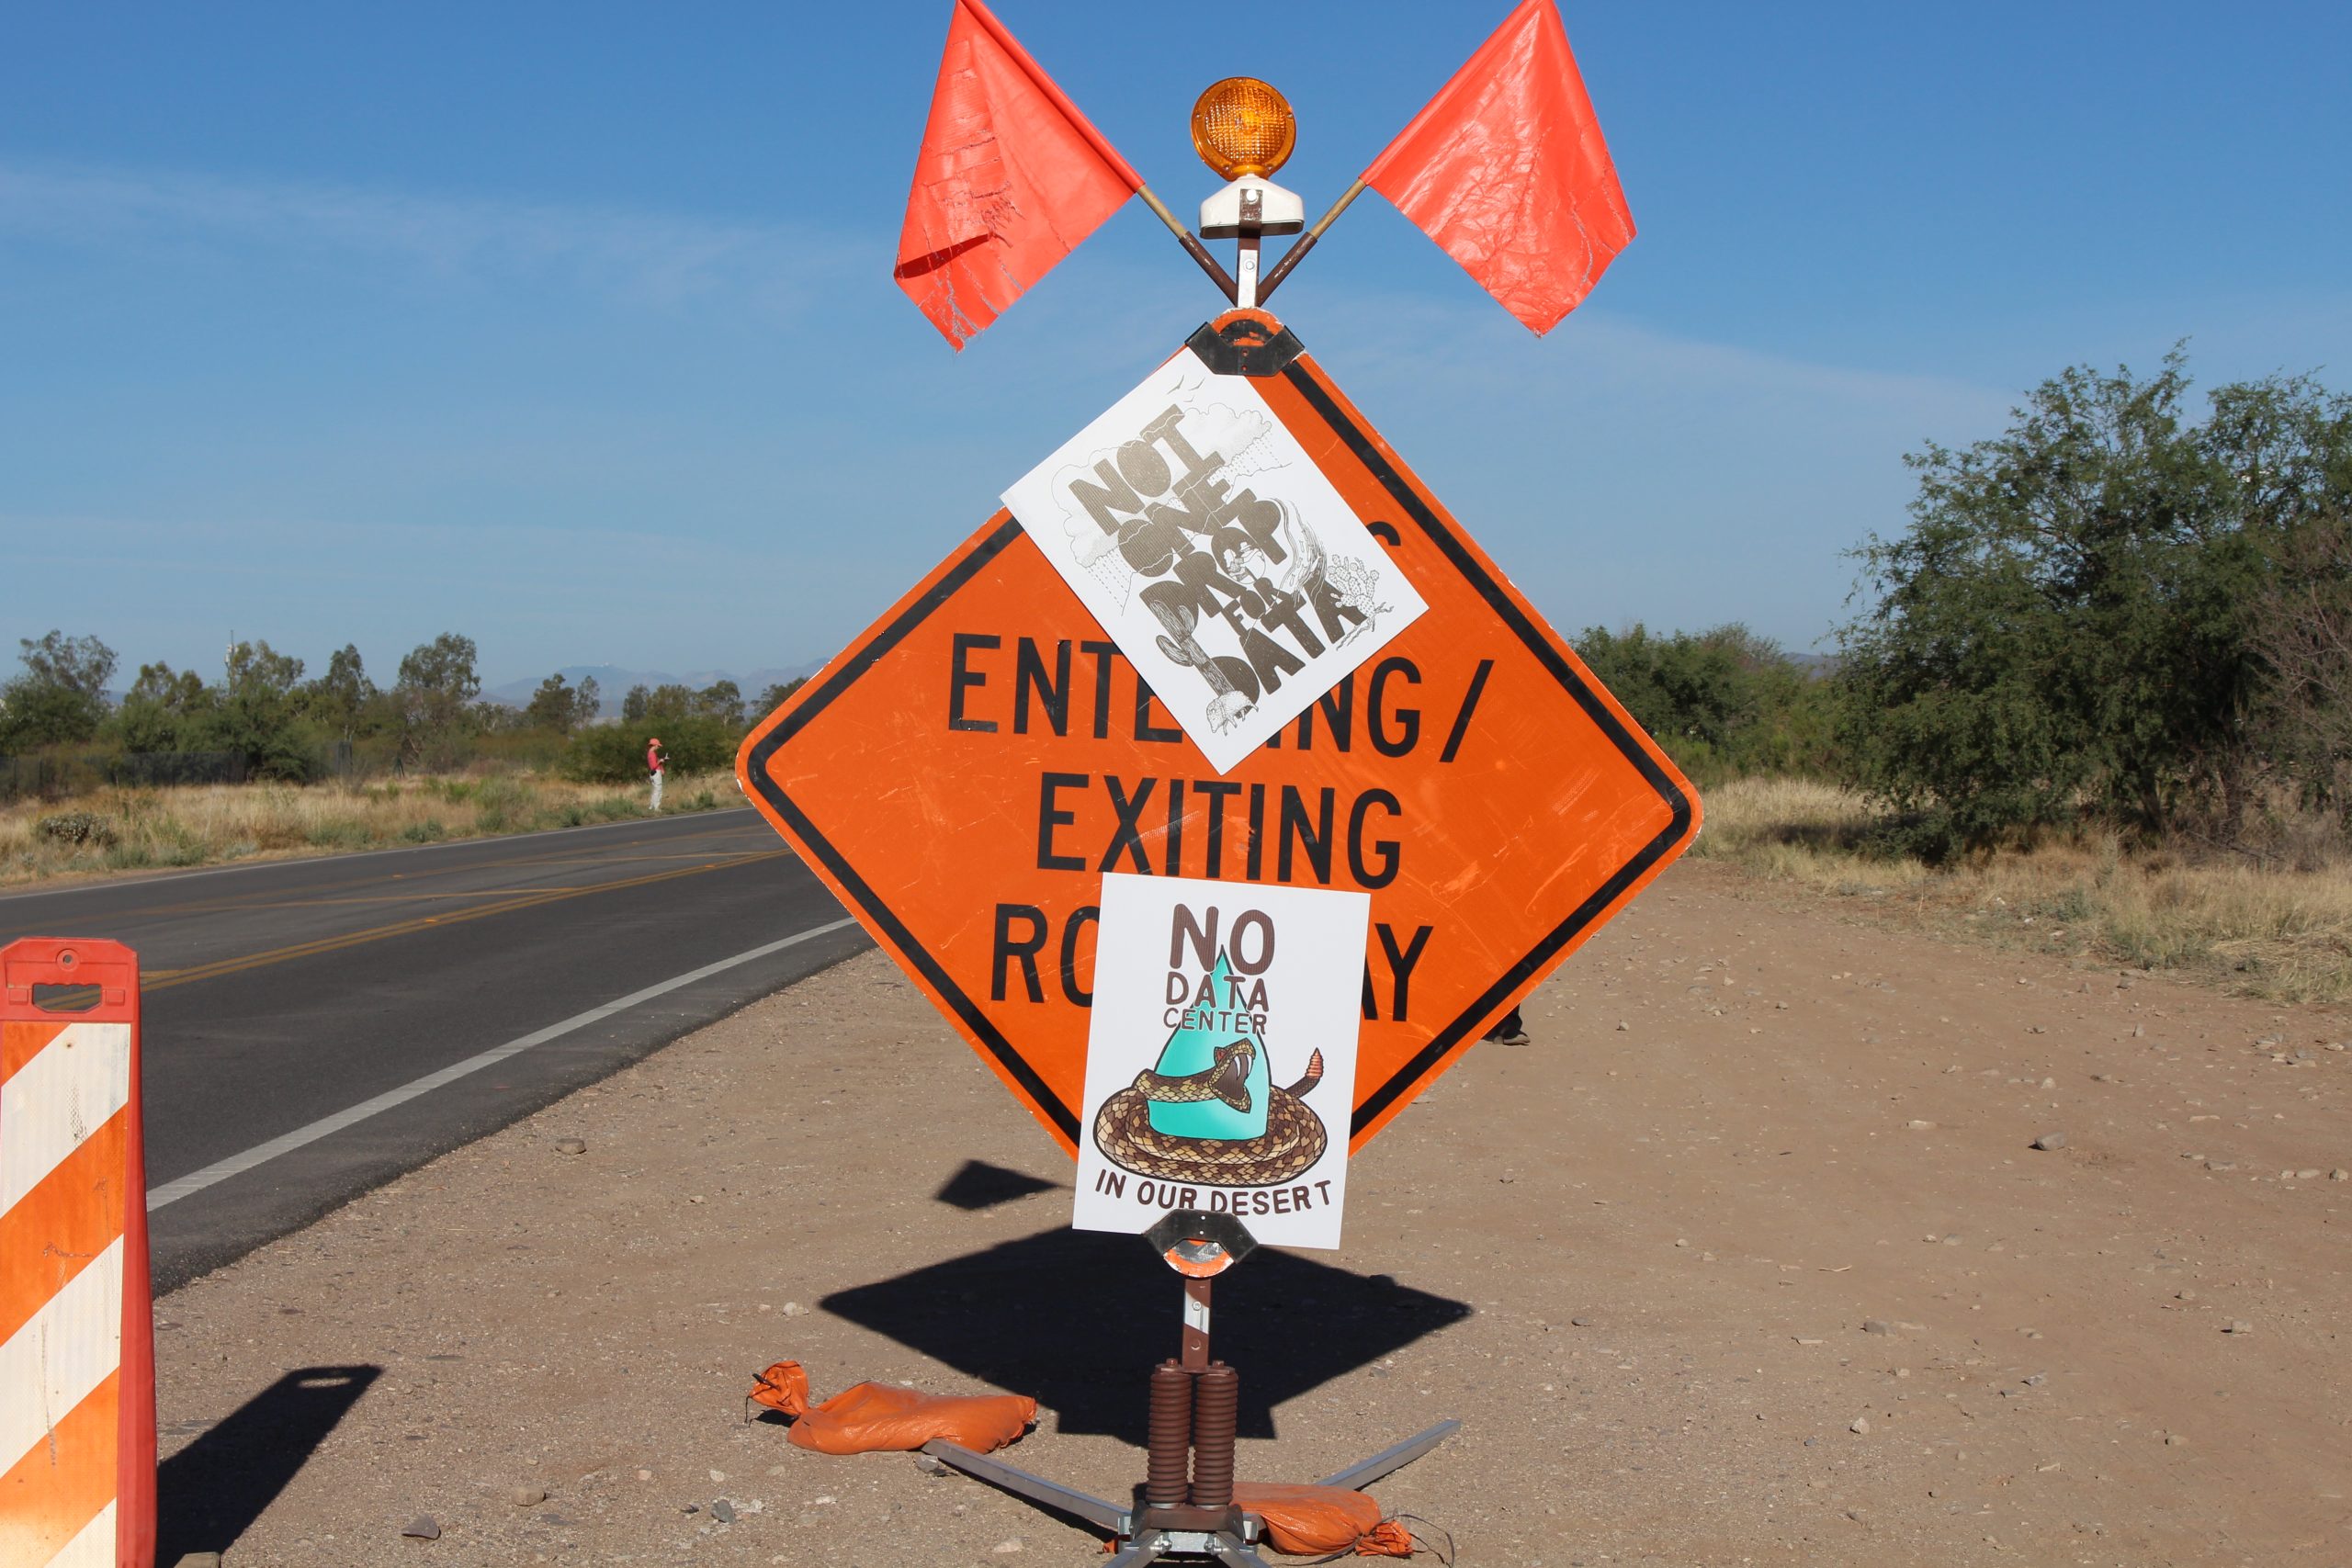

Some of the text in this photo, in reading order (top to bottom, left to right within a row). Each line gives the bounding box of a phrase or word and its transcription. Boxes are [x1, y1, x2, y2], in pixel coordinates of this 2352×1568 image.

[1069, 403, 1205, 536] NOT
[1118, 451, 1258, 577] ONE
[1139, 500, 1288, 642] DROP
[1221, 577, 1290, 636] FOR
[948, 633, 1495, 762] ENTENG/
[1200, 568, 1368, 719] DATA
[1036, 772, 1402, 889] EXITING
[1166, 971, 1270, 1013] DATA
[1170, 903, 1275, 976] NO
[1163, 1007, 1268, 1035] CENTER
[1095, 1168, 1331, 1216] IN OUR DESERT
